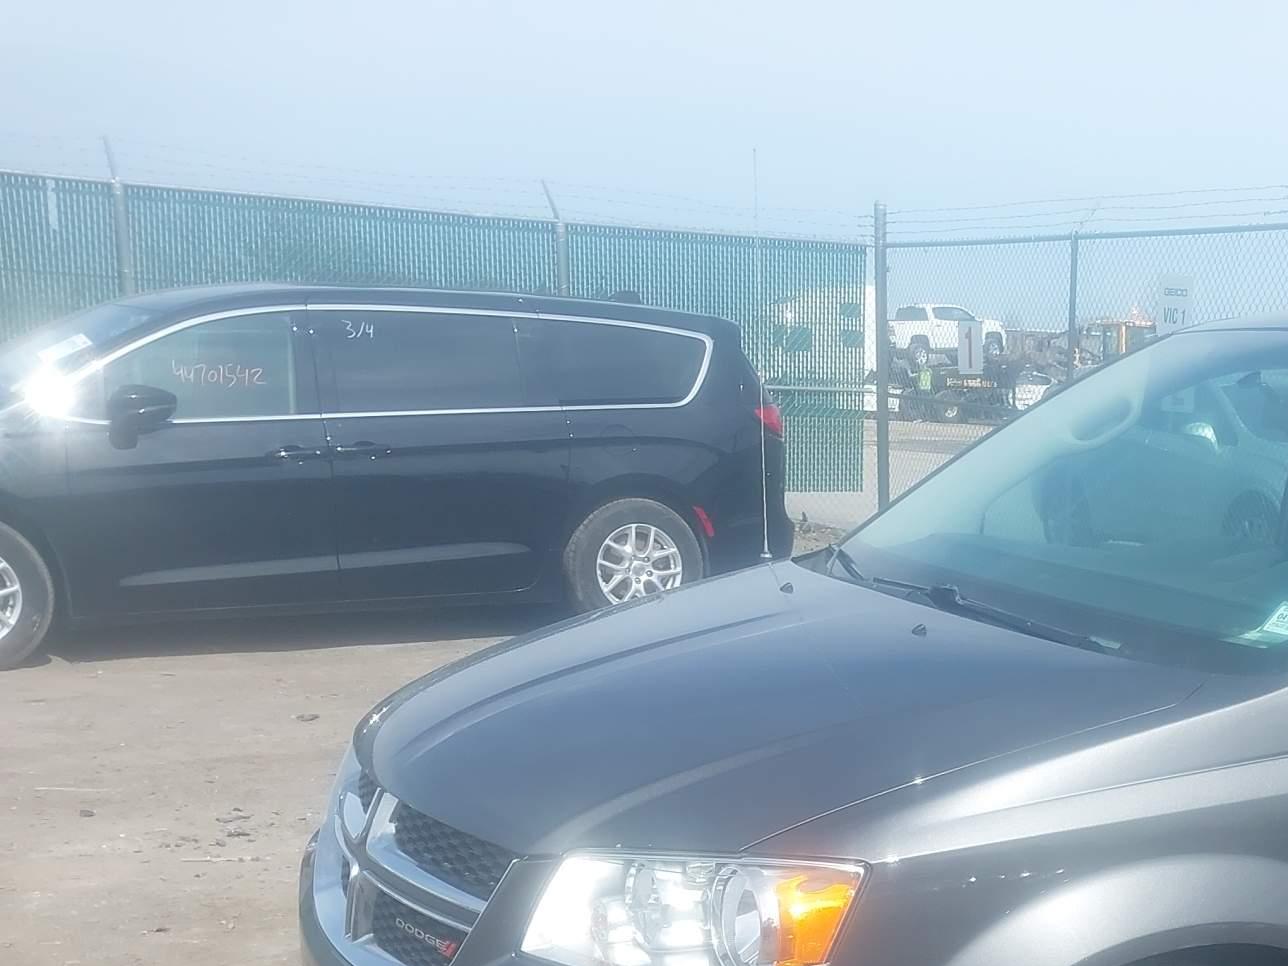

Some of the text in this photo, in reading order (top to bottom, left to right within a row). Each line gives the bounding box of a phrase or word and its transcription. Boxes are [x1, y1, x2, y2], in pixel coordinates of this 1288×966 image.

[341, 319, 375, 338] 3/4
[1163, 306, 1186, 325] VIC 1
[964, 326, 973, 369] 1
[171, 360, 267, 388] 44701542
[395, 917, 449, 950] DODGE
